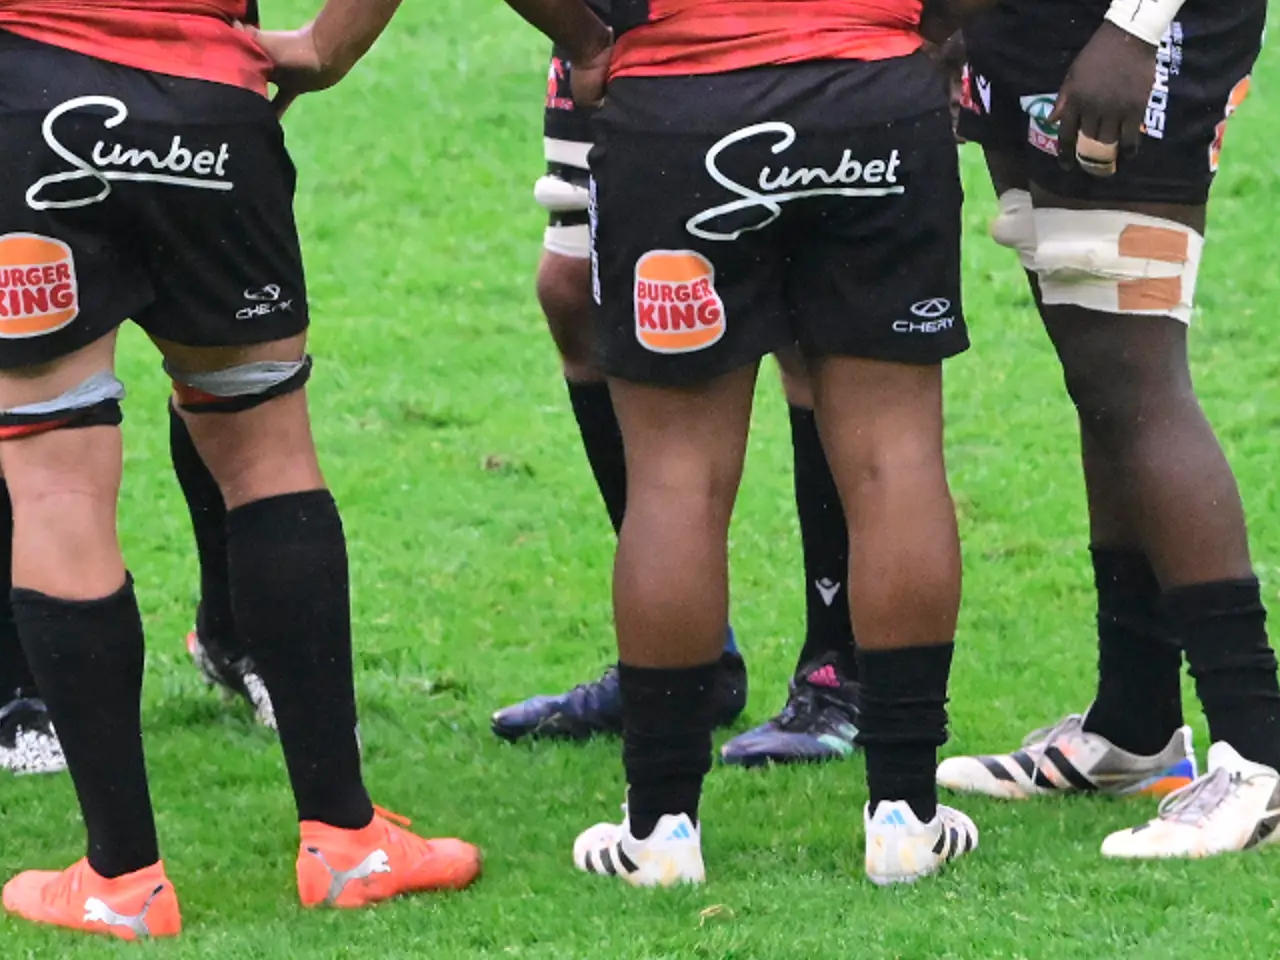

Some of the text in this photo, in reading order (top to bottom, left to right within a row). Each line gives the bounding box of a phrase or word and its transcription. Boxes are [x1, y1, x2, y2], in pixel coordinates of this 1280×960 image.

[26, 96, 234, 211] Sunbet
[686, 121, 905, 240] Sunbet
[637, 278, 713, 304] BURGER
[638, 298, 721, 331] KING
[893, 316, 955, 333] CHERY
